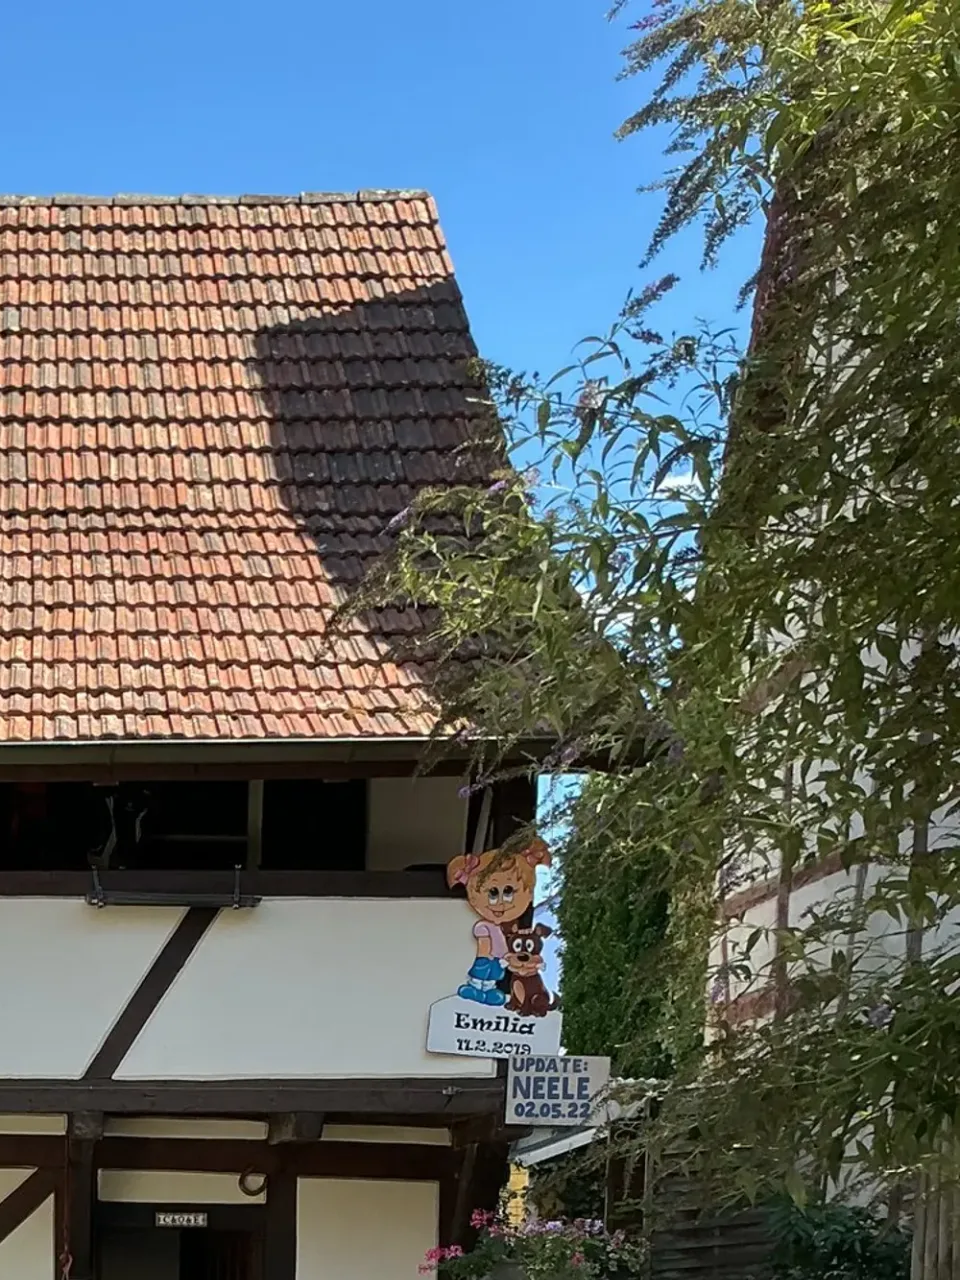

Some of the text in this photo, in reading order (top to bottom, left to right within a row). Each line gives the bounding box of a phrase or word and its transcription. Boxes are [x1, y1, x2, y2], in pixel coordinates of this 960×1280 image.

[454, 1012, 536, 1035] Emilia
[512, 1057, 589, 1073] UPDATE:
[512, 1076, 590, 1100] NEELE
[514, 1102, 590, 1119] 02.05.22
